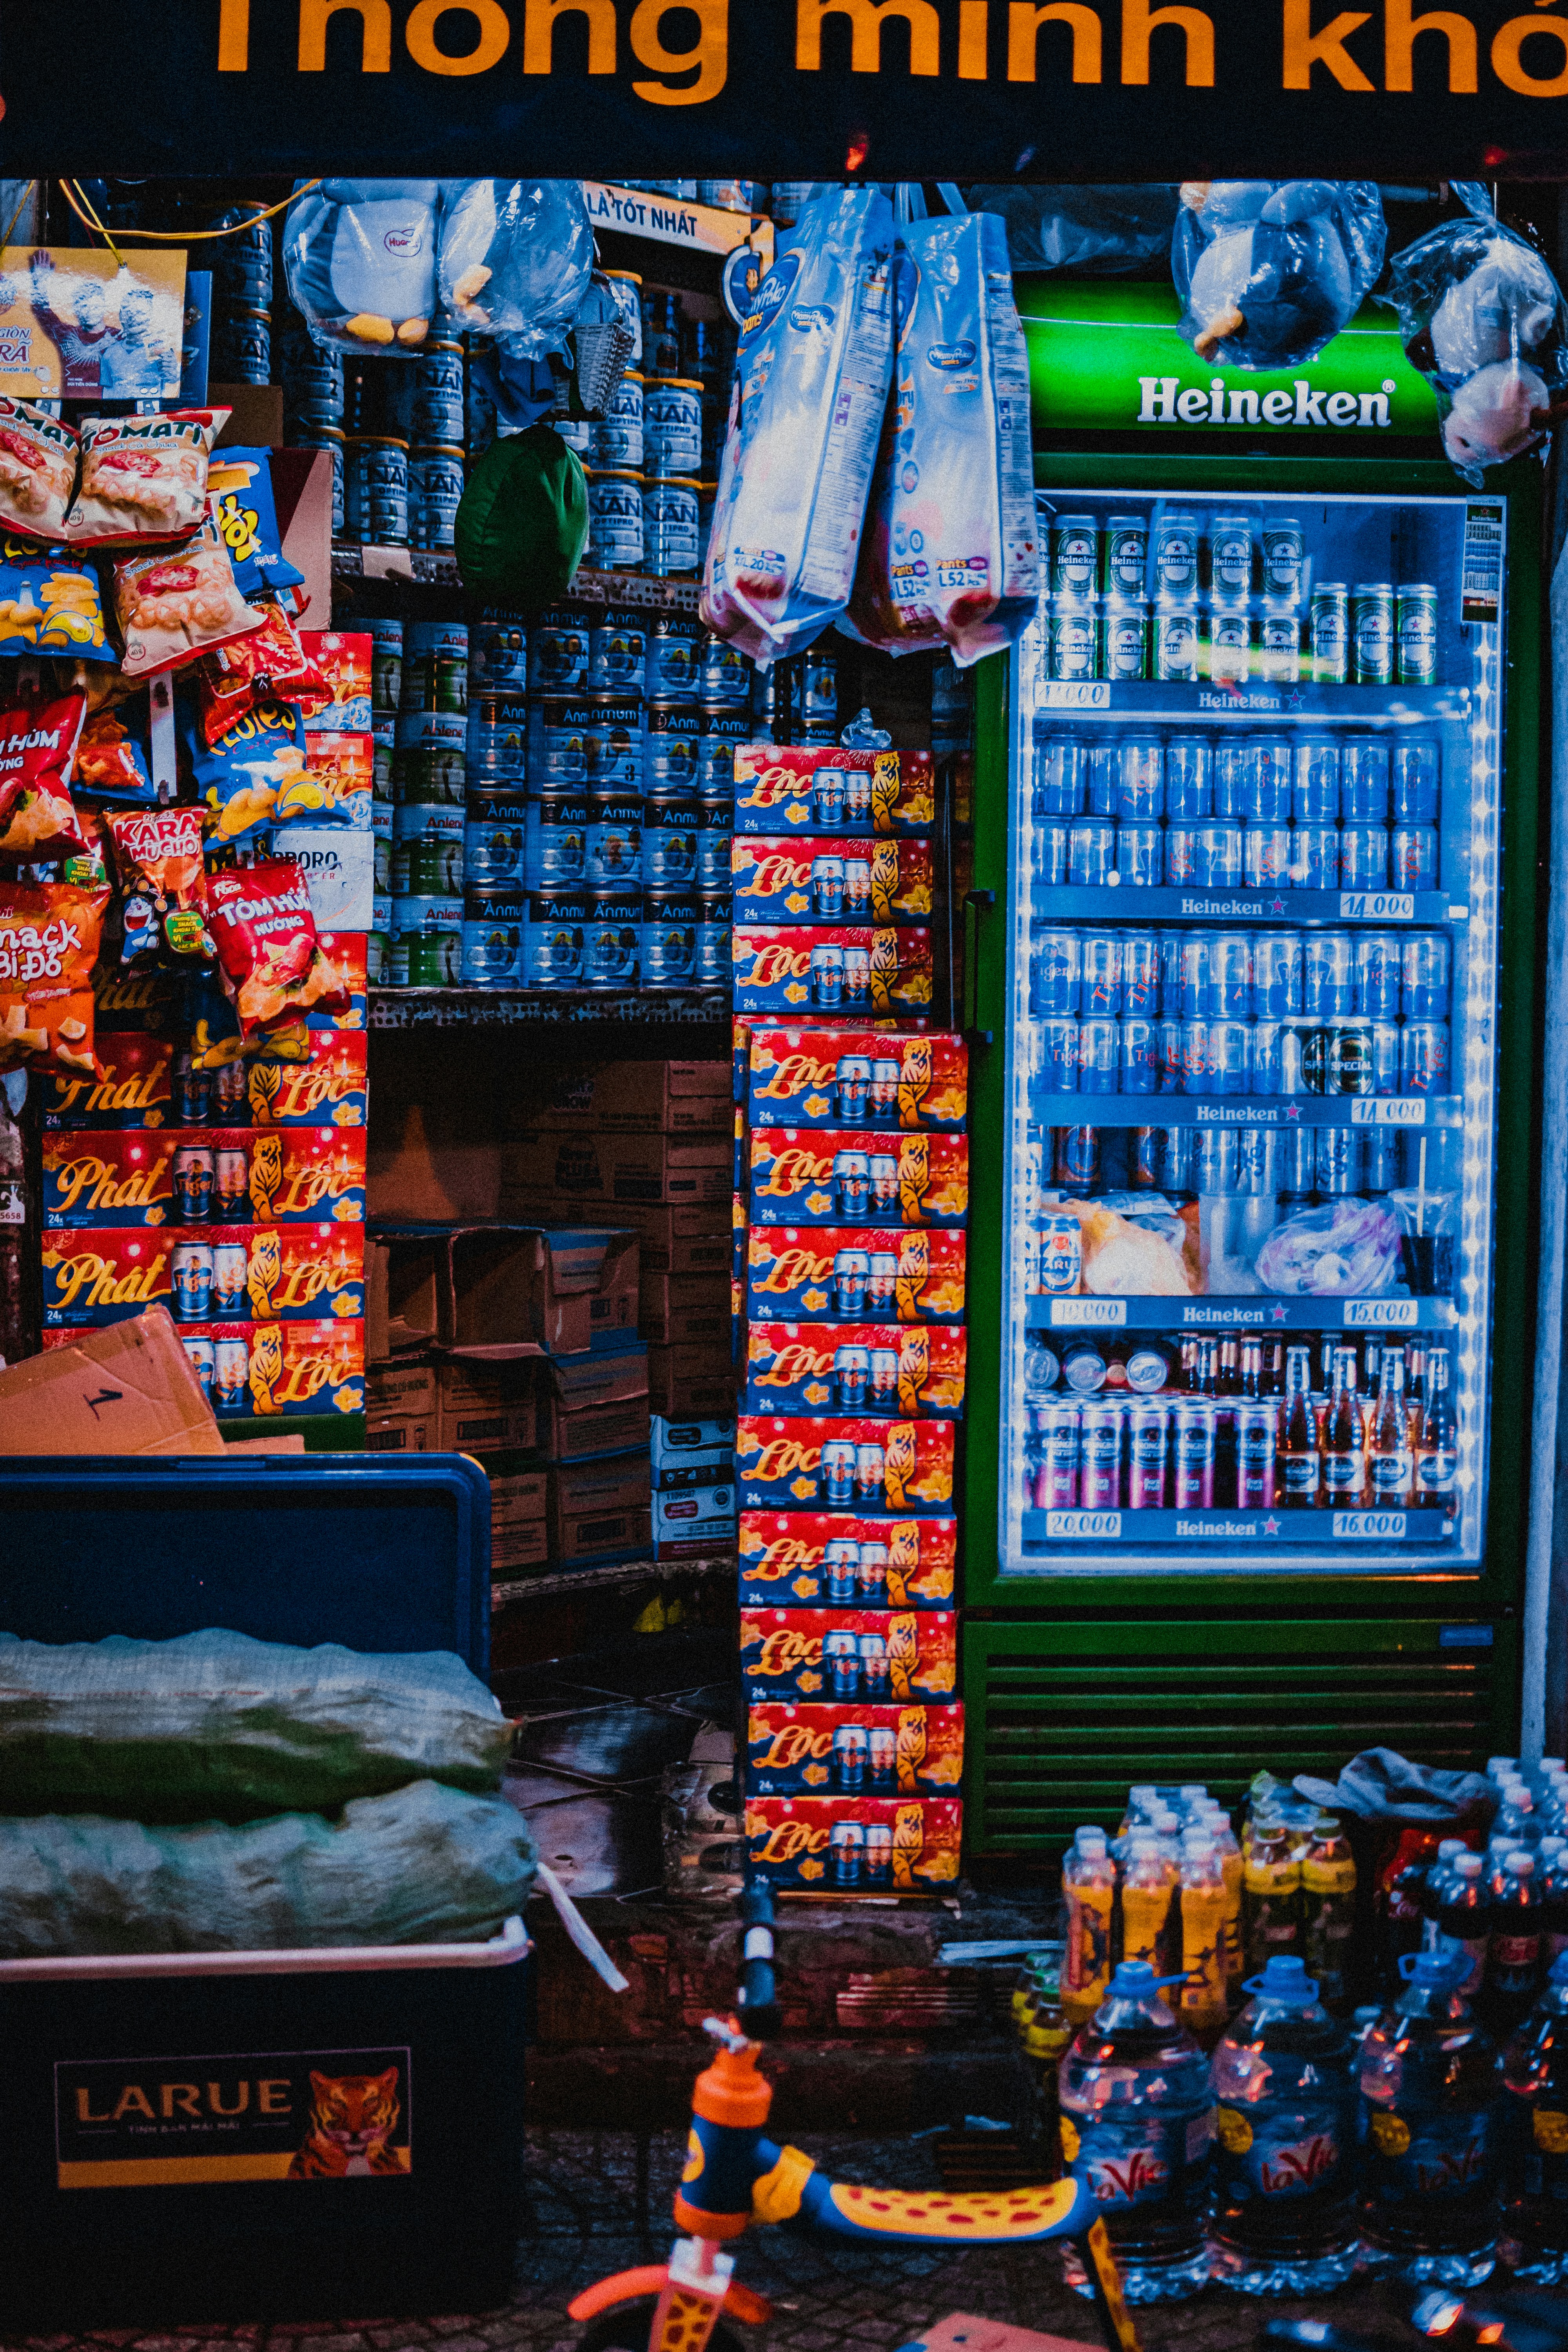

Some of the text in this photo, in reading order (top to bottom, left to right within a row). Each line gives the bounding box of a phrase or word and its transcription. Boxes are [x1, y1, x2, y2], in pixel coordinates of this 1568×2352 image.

[651, 209, 697, 236] NHẤT
[1137, 377, 1392, 427] Heineken
[83, 420, 202, 454] TOMATI
[1199, 692, 1280, 709] Heineken
[114, 813, 199, 848] KARA
[130, 835, 199, 862] MUCHO
[217, 896, 274, 927] TÔM
[1181, 898, 1263, 915] Heineken
[1330, 1061, 1372, 1071] SPECIAL
[1196, 1105, 1278, 1121] Heineken
[47, 1156, 173, 1213] Phát
[46, 1252, 172, 1309] Phát
[1183, 1307, 1264, 1322] Heineken
[1176, 1520, 1256, 1536] Heineken
[75, 2078, 292, 2122] LARUE
